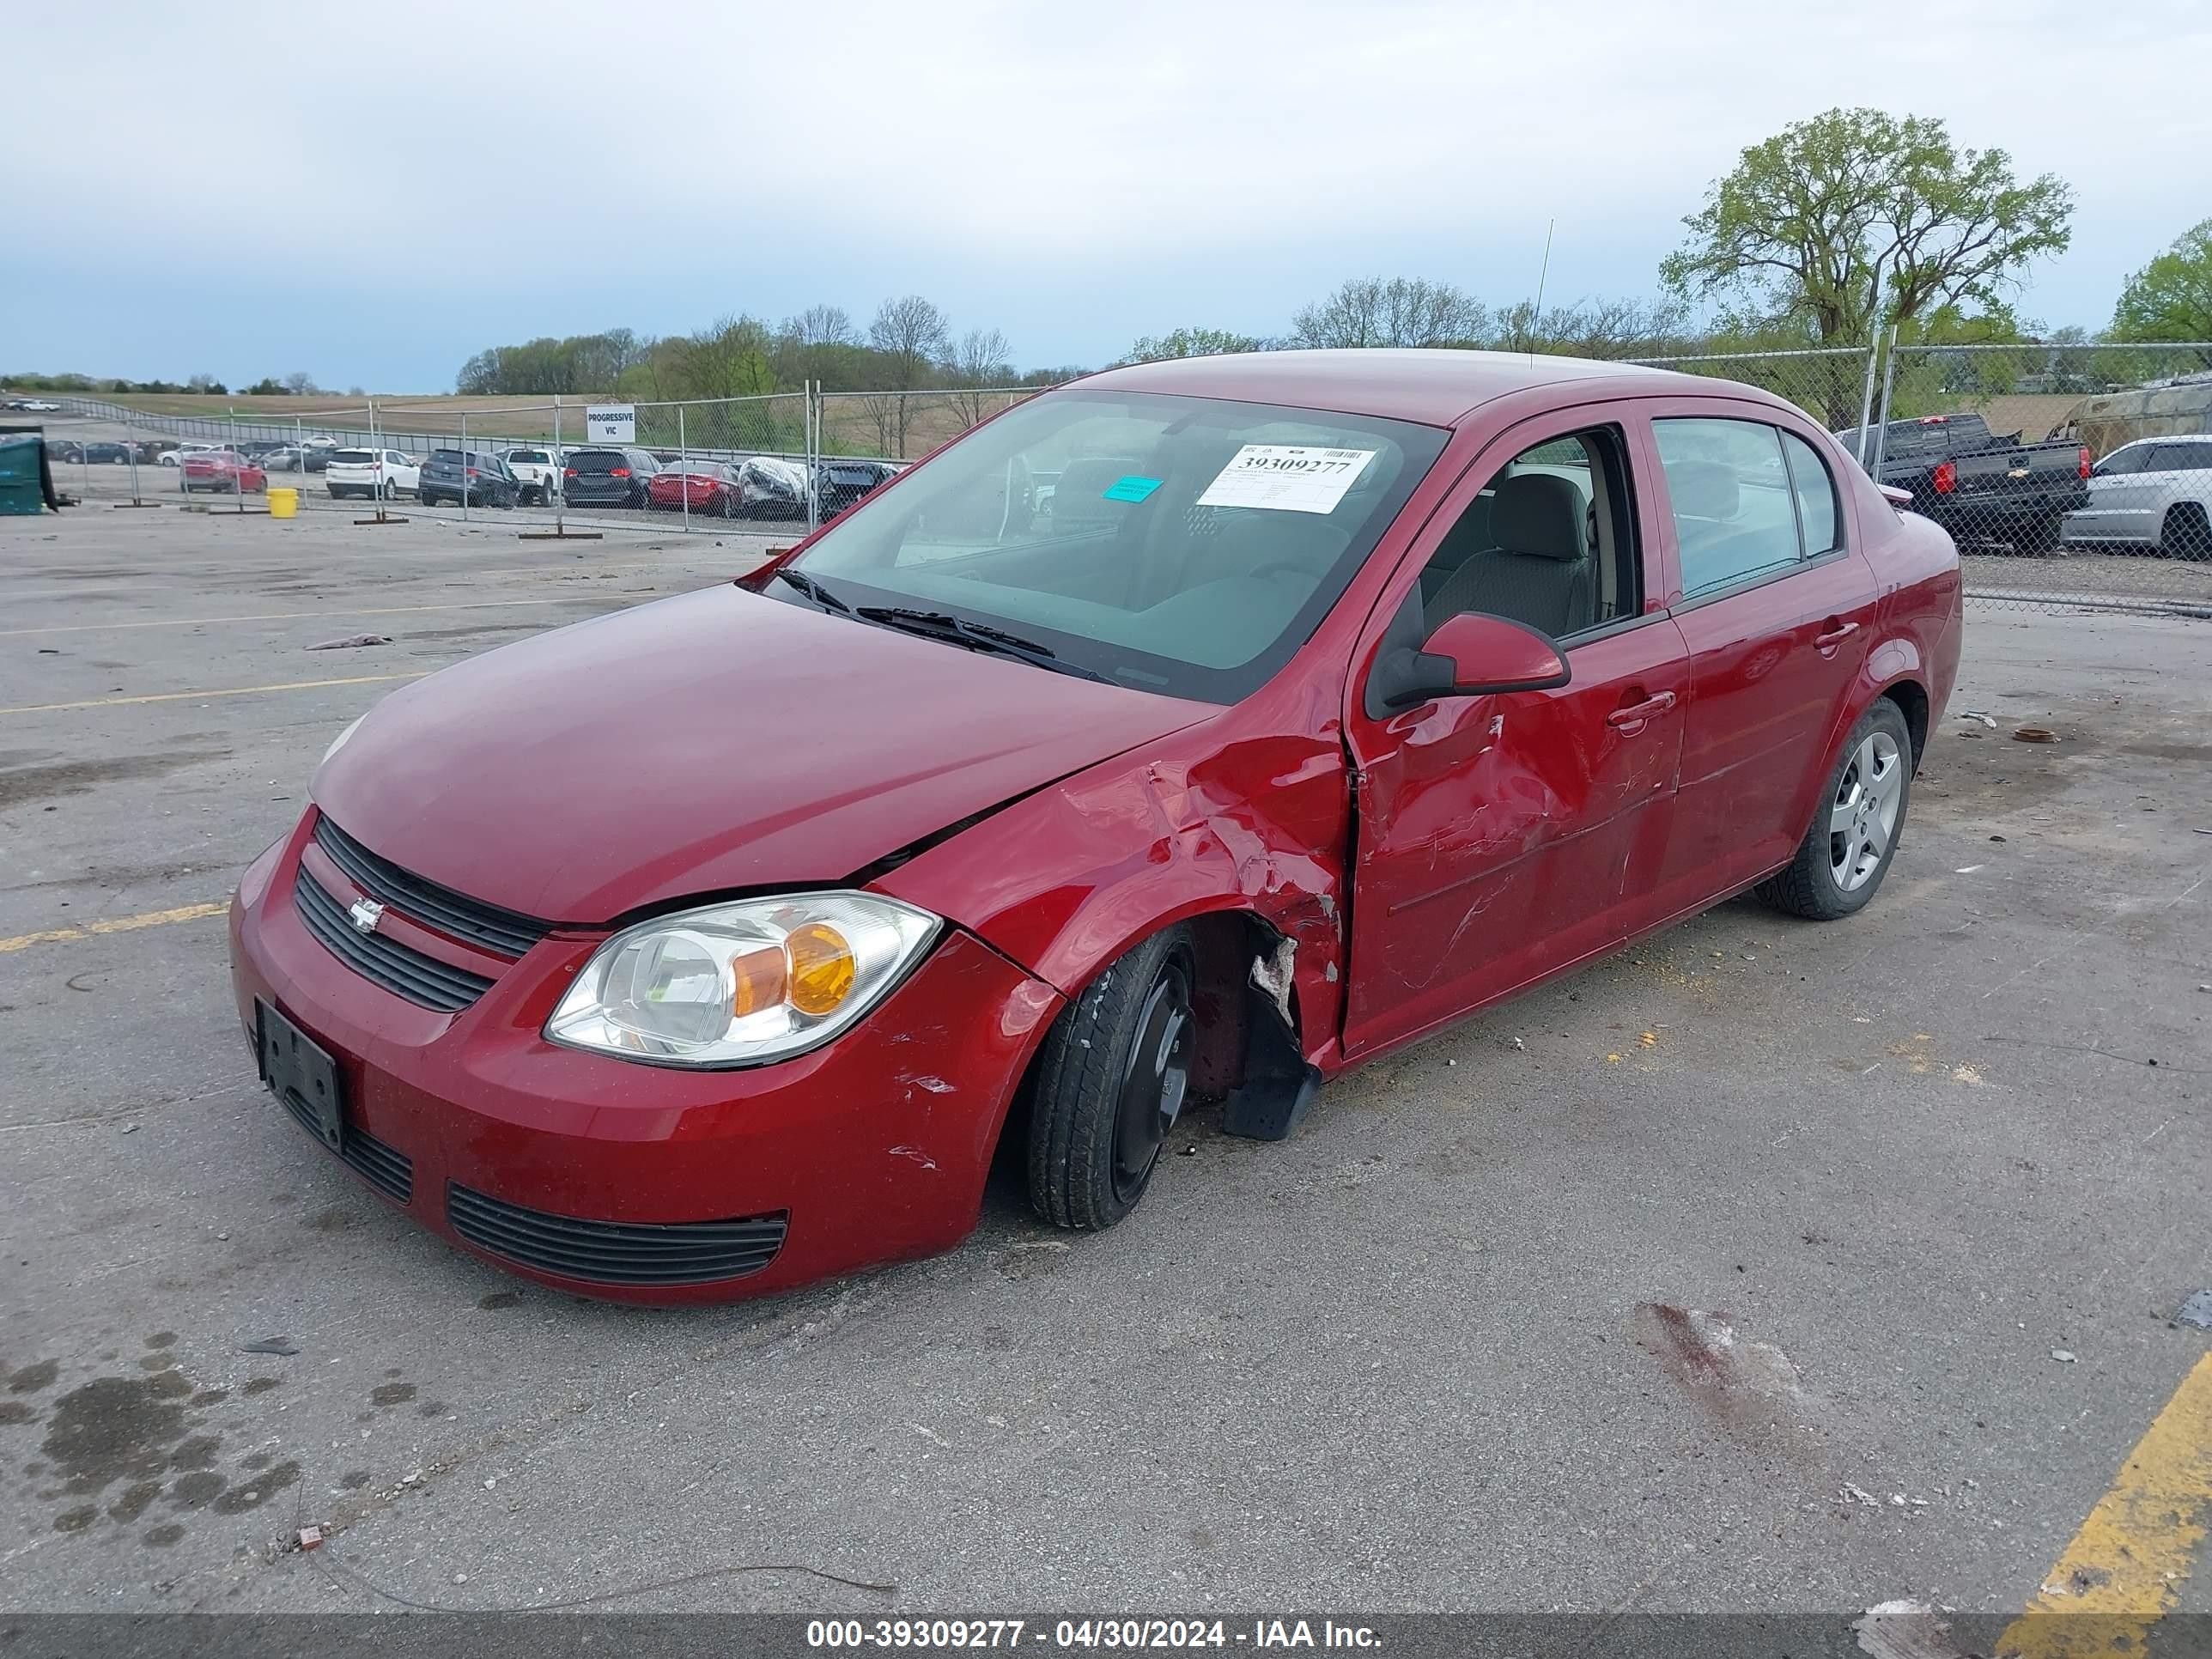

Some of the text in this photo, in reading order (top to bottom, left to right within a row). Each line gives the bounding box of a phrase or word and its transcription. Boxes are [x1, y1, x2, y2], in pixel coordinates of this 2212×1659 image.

[588, 412, 634, 422] PROGRESSIVE
[605, 426, 617, 435] VIC
[1237, 457, 1352, 474] 39309277
